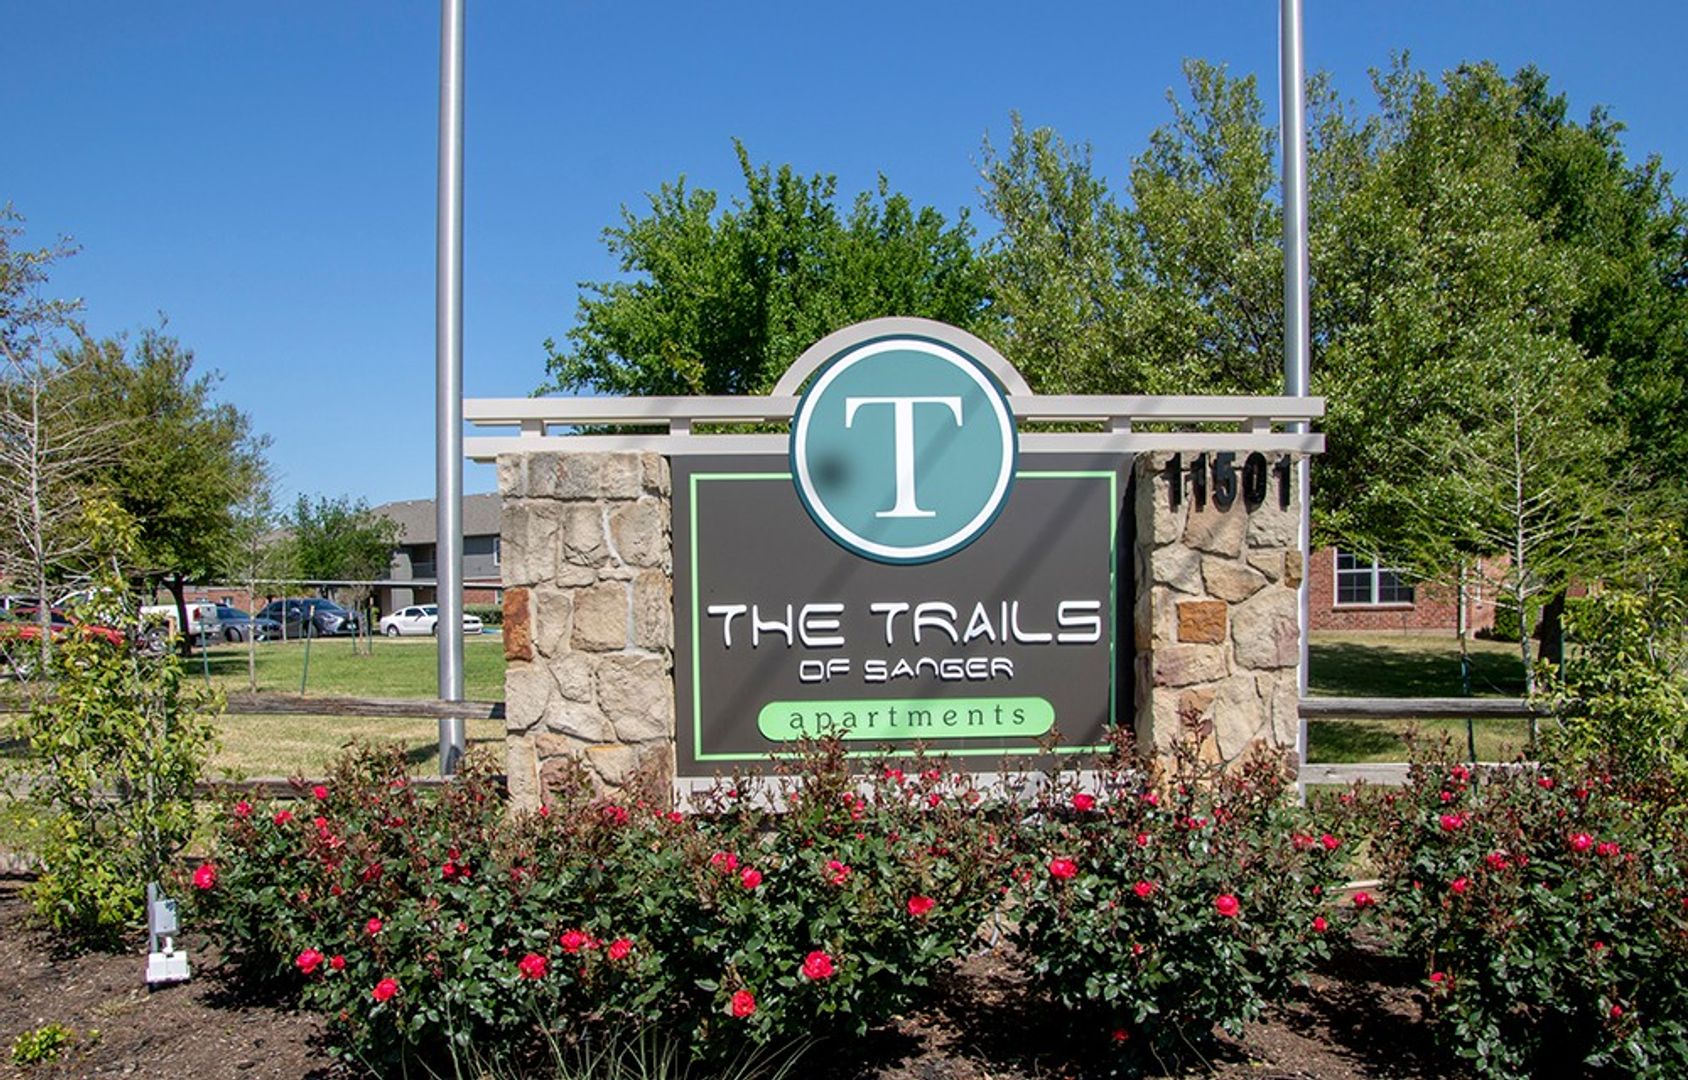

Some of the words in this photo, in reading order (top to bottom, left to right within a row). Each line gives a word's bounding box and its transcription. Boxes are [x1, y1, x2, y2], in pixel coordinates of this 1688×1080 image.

[845, 396, 963, 517] T
[1162, 452, 1291, 508] 11501
[707, 603, 845, 646] THE
[870, 600, 1101, 644] TRAILS
[799, 659, 850, 682] OF
[864, 656, 1014, 682] SANGER
[789, 703, 1026, 734] apartments
